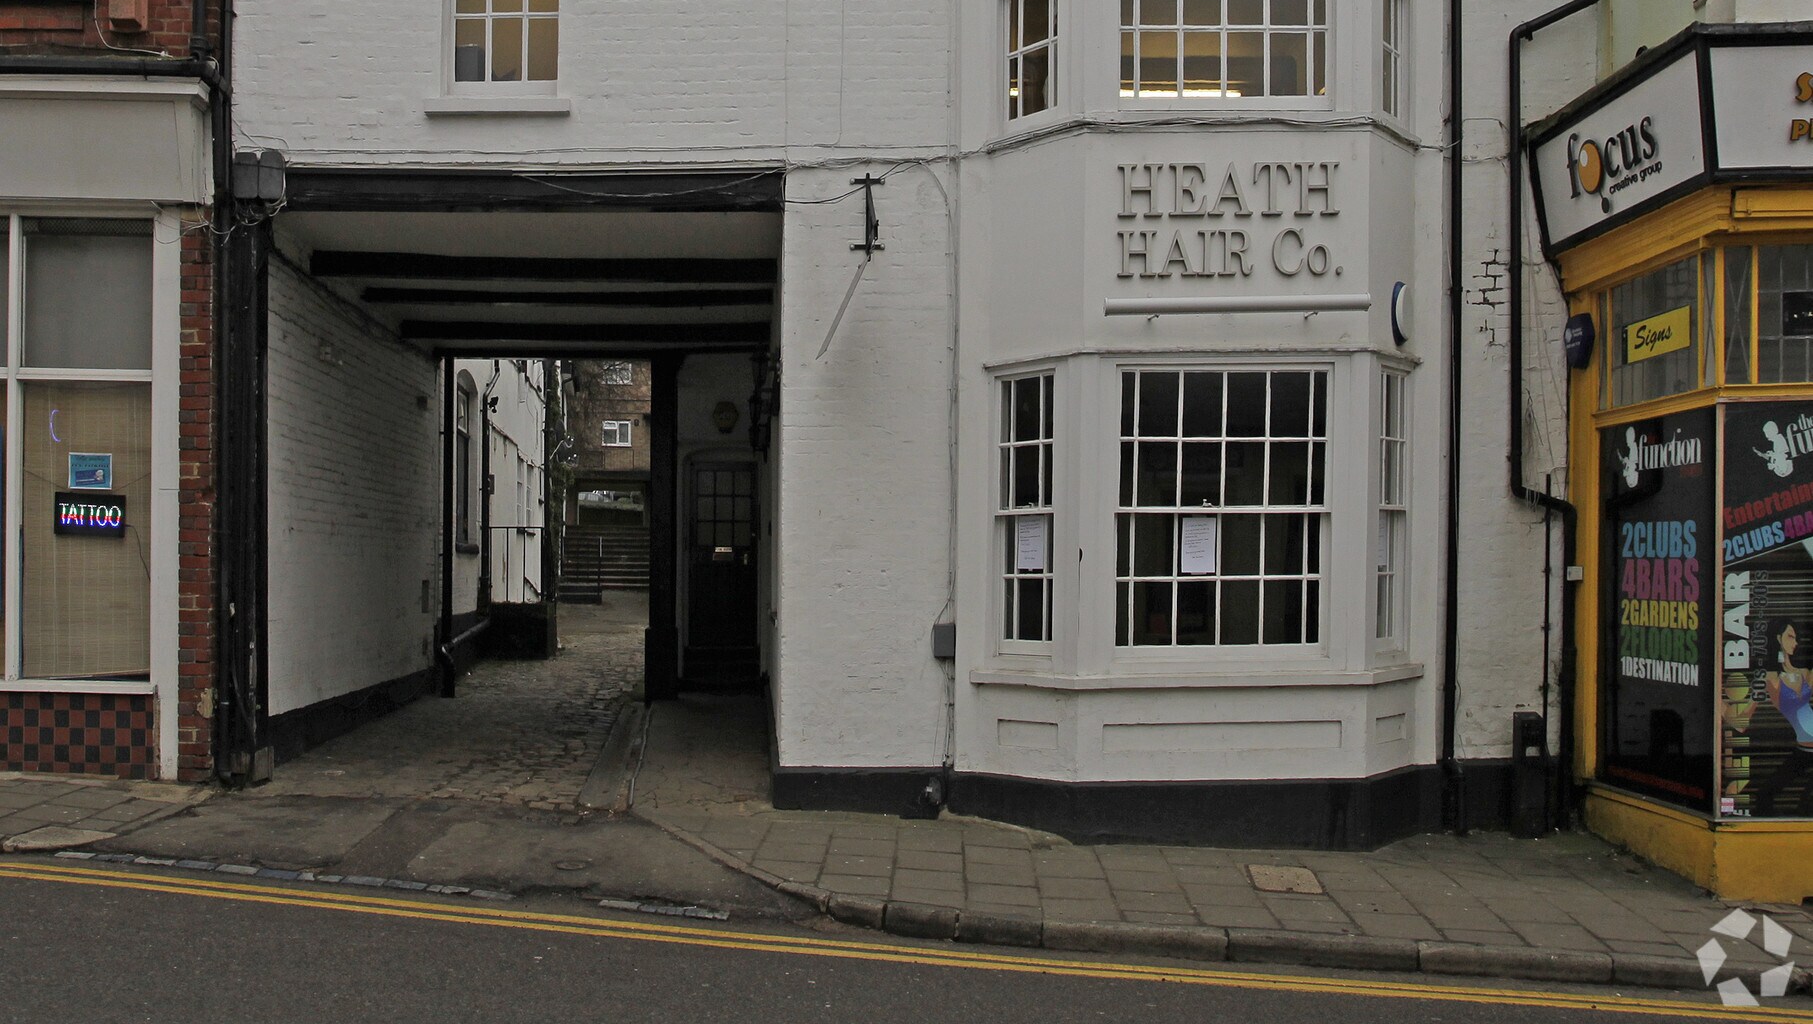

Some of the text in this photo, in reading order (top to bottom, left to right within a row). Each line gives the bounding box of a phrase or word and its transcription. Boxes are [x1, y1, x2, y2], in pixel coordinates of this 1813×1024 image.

[1567, 116, 1656, 199] focus
[1609, 161, 1662, 194] creative group
[1117, 161, 1340, 218] HEATH
[1117, 228, 1343, 278] HAIR Co.
[1634, 325, 1672, 351] Signs
[1638, 428, 1702, 471] function
[1786, 423, 1813, 459] fu
[59, 503, 121, 527] TATTOO
[1724, 482, 1813, 529] Entertain
[1621, 519, 1697, 559] 2CLUBS
[1621, 558, 1699, 602] 4BARS
[1621, 599, 1698, 631] 2GARDENS
[1724, 570, 1750, 669] BAR
[1620, 626, 1698, 664] 2FLOORS
[1620, 656, 1698, 687] 1DESTINATION
